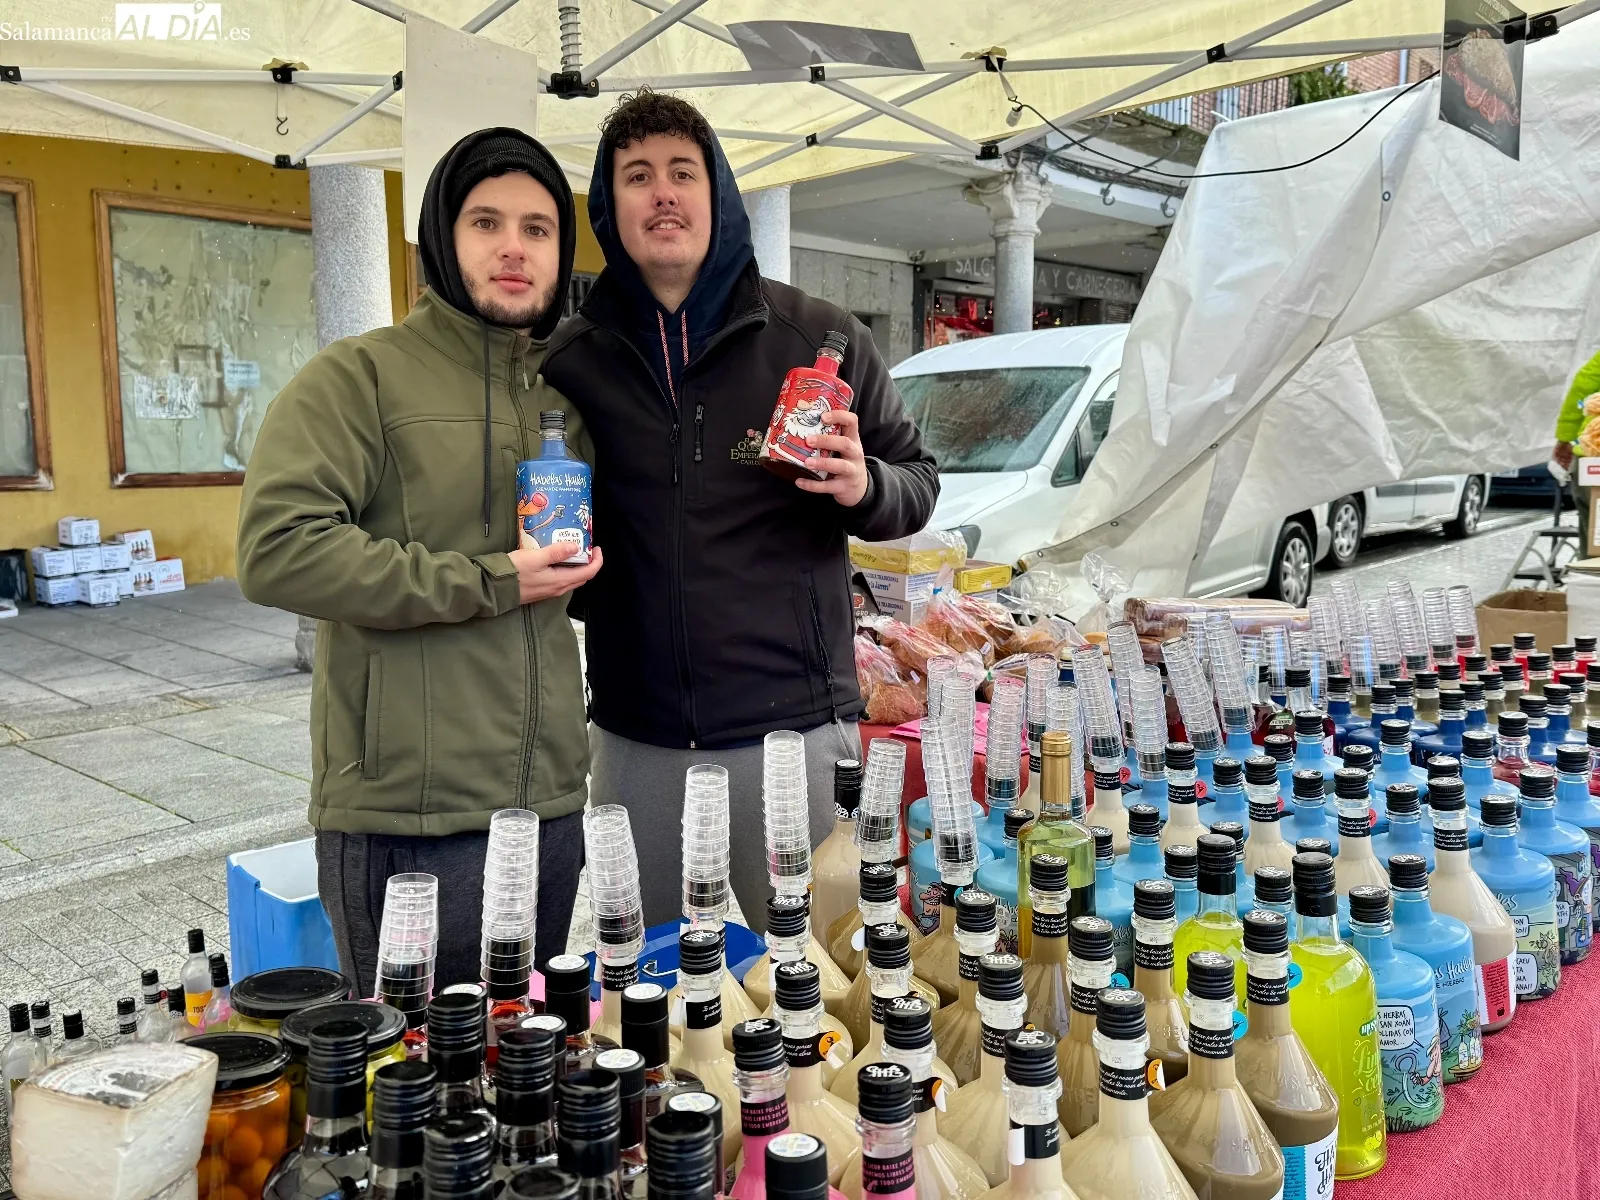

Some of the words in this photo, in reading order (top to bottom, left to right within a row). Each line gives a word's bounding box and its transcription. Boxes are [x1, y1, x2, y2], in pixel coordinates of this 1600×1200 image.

[530, 472, 562, 486] Habelas
[1383, 1010, 1406, 1019] HERBAS
[1379, 1020, 1393, 1029] SAN
[1394, 1018, 1411, 1028] XOAN
[1402, 1027, 1414, 1037] CON
